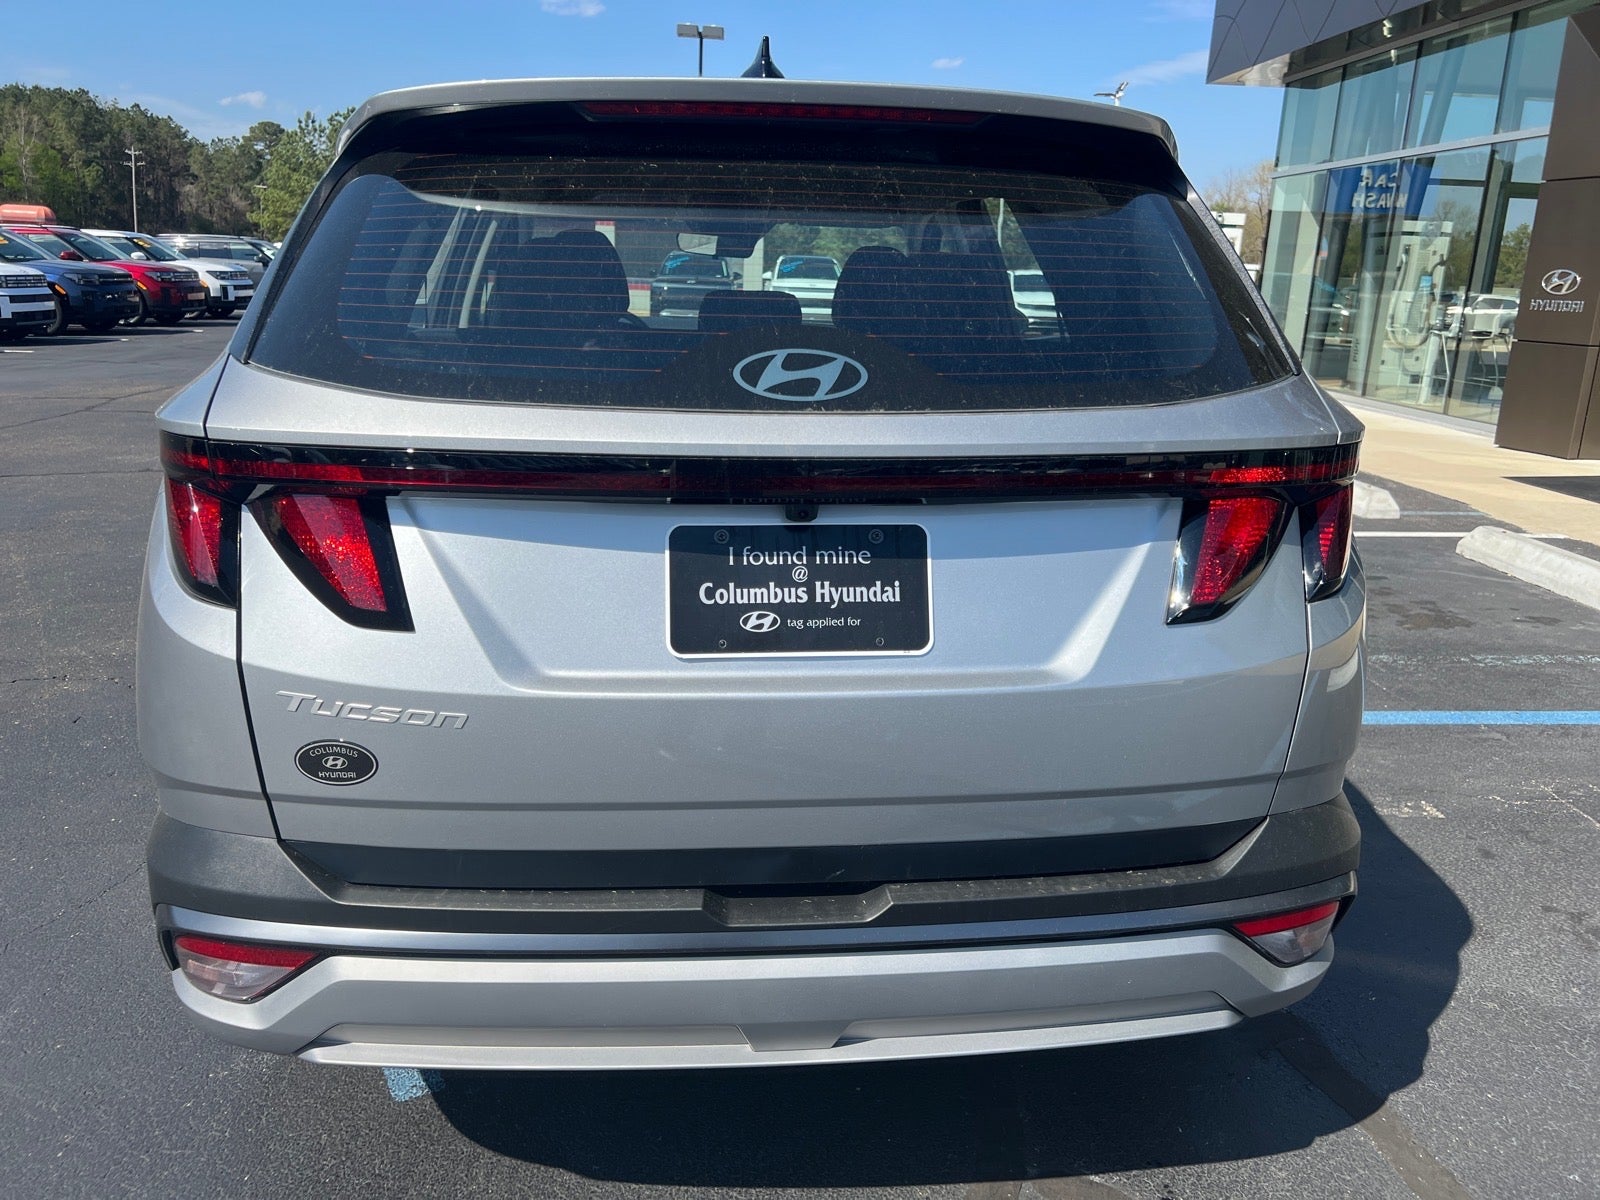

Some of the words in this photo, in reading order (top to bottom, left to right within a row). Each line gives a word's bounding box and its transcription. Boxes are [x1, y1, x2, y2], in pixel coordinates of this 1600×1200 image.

[1529, 299, 1585, 313] HYUNDAI
[729, 547, 734, 566] I
[743, 546, 807, 566] found
[816, 546, 872, 565] mine
[792, 566, 808, 583] @
[699, 582, 808, 605] Columbus
[815, 580, 901, 609] Hyundai
[787, 617, 804, 629] tag
[806, 616, 844, 628] applied
[847, 616, 862, 627] for
[309, 746, 359, 758] COLUMBUS
[318, 771, 357, 779] HYUNDAI
